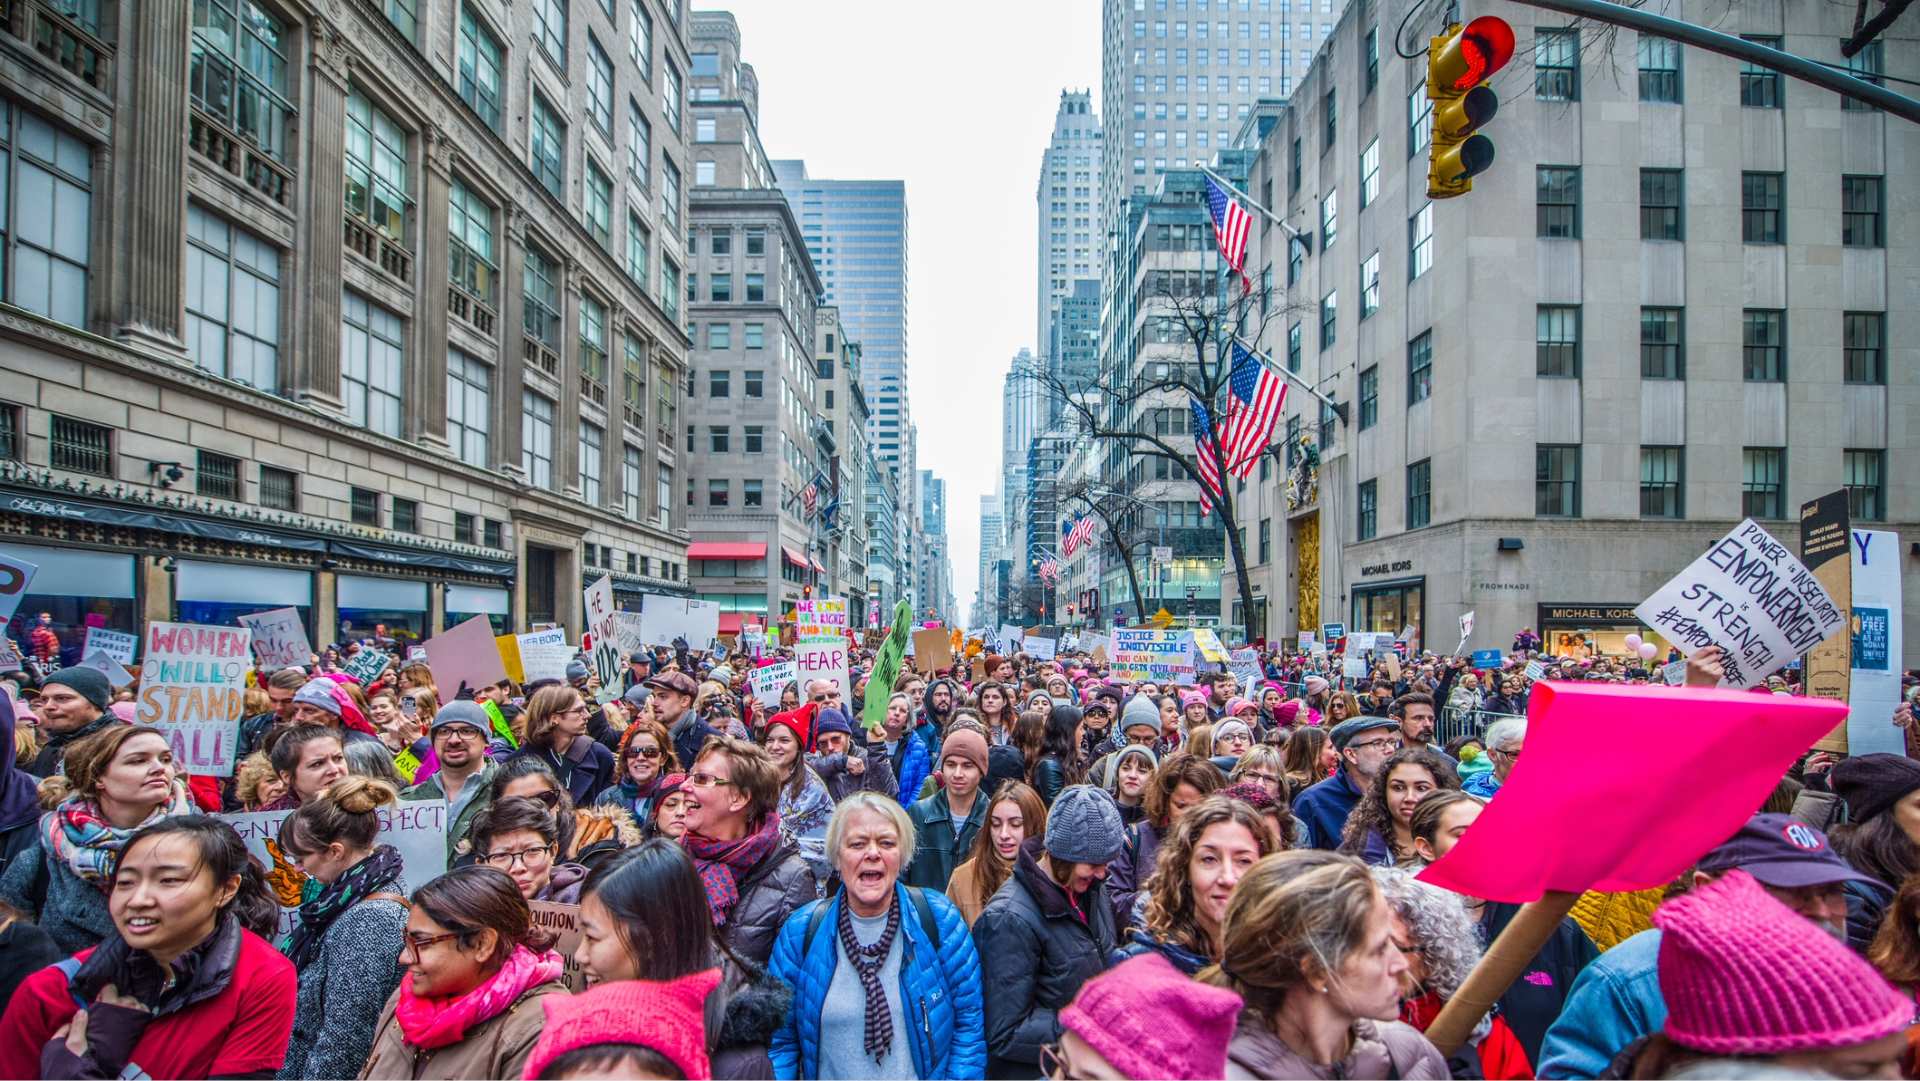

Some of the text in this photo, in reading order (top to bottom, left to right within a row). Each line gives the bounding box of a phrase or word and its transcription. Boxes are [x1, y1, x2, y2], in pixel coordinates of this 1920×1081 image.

[1361, 559, 1412, 577] MICHAEL KORS
[1740, 523, 1787, 567] POWER
[1791, 569, 1842, 630] INSECURITY
[1479, 582, 1530, 591] PROMENADE
[591, 591, 603, 615] HE
[797, 600, 814, 612] WE
[1706, 537, 1825, 656] EMPOWERMENT
[1552, 608, 1636, 619] MICHAEL KORS
[600, 612, 617, 640] NOT
[1116, 631, 1178, 640] JUSTICE IS
[1681, 583, 1775, 671] STRENGTH
[1862, 621, 1885, 632] FREE
[152, 626, 248, 658] WOMEN
[540, 634, 562, 645] BODY
[770, 663, 787, 671] WANT
[797, 650, 843, 671] HEAR
[1129, 662, 1148, 671] GETS
[160, 660, 225, 684] WILL
[774, 670, 793, 680] WORK
[760, 683, 773, 693] FOR
[138, 685, 242, 724] STAND
[376, 806, 445, 833] SPECT,
[529, 910, 579, 933] OLUTION,
